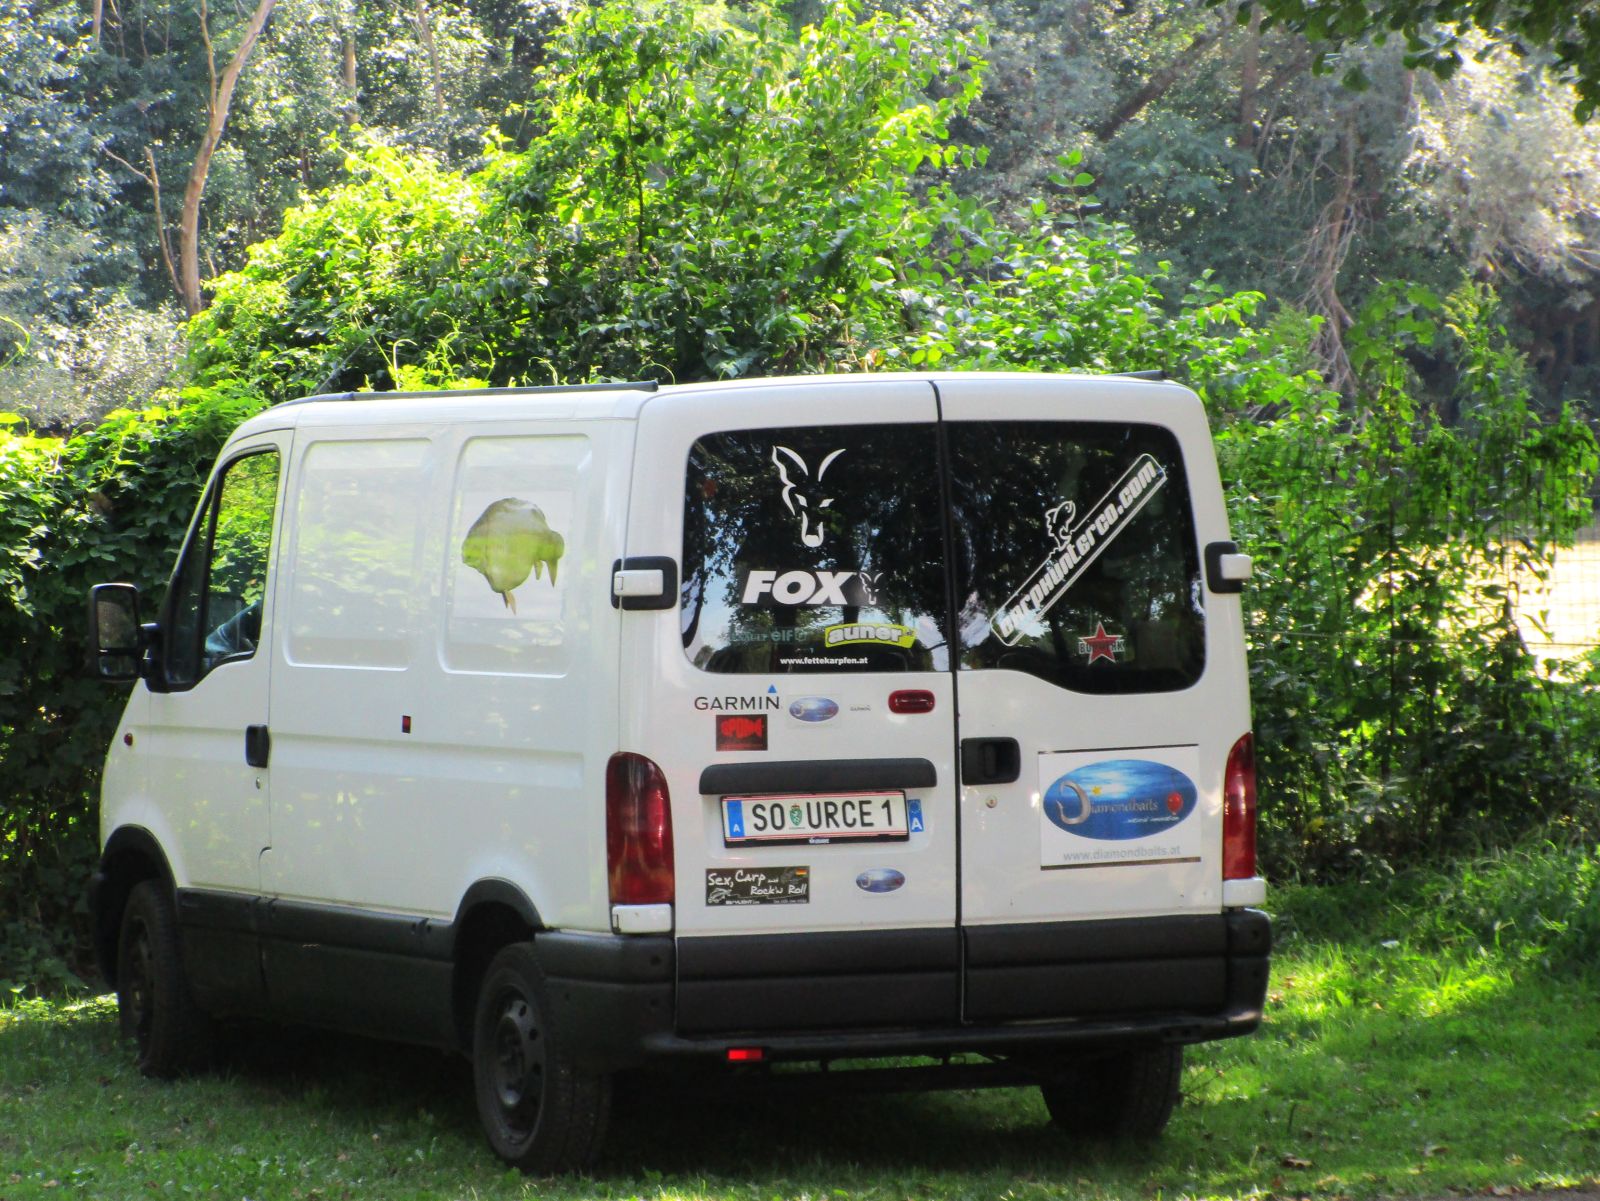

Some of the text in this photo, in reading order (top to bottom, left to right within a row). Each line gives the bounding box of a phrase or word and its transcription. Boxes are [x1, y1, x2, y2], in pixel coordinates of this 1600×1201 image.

[742, 570, 857, 605] FOX
[827, 624, 902, 645] auner
[779, 656, 869, 666] www.fettekarpfen.at
[694, 696, 780, 711] GARMIN
[752, 799, 892, 832] SO URCE 1
[733, 823, 741, 833] A
[910, 817, 924, 831] A
[1063, 846, 1181, 862] www.diamondbaits.at
[707, 872, 734, 888] Sex,
[788, 883, 808, 895] Roll
